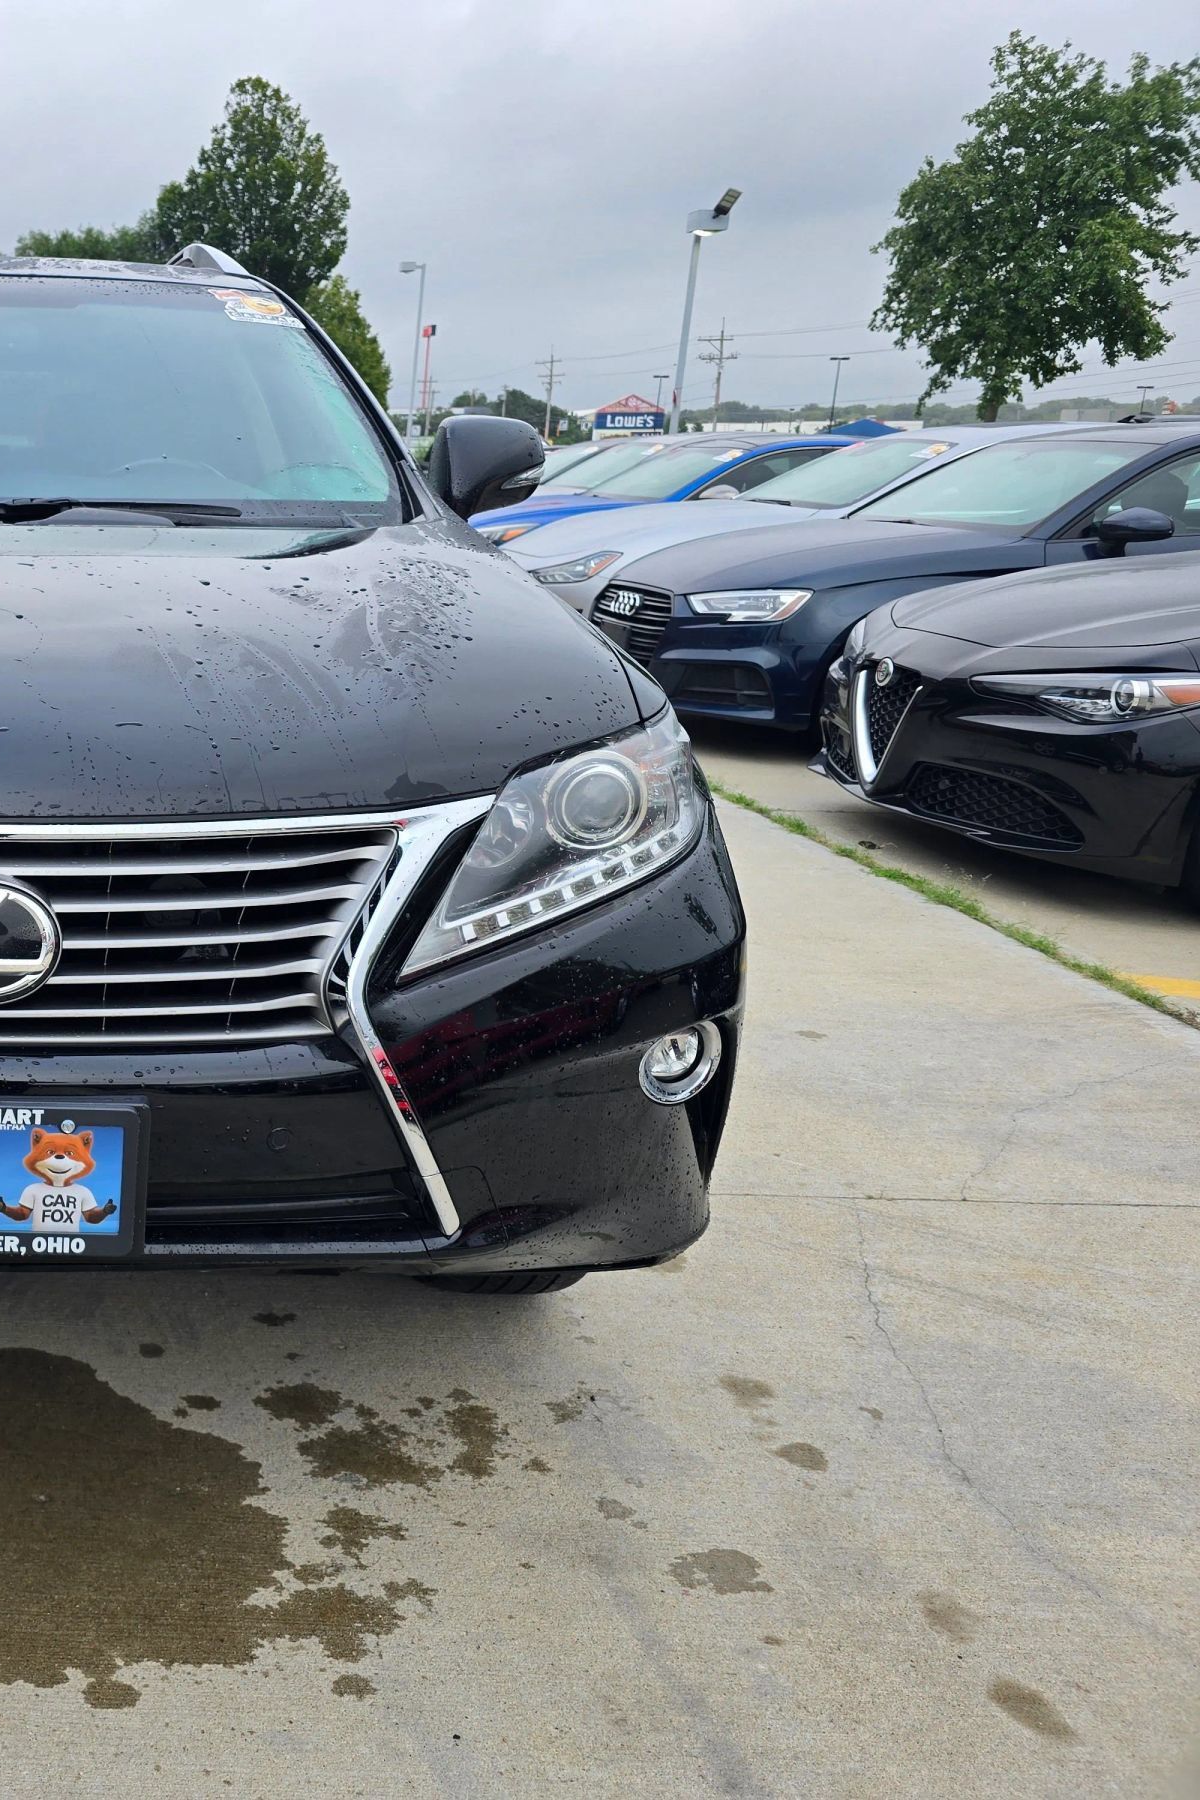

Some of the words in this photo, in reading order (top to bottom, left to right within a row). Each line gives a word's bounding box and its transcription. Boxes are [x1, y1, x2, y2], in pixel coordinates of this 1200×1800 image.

[606, 414, 655, 428] LOWE'S
[42, 1194, 77, 1210] CAR
[42, 1209, 75, 1224] FOX
[32, 1237, 86, 1254] OHIO
